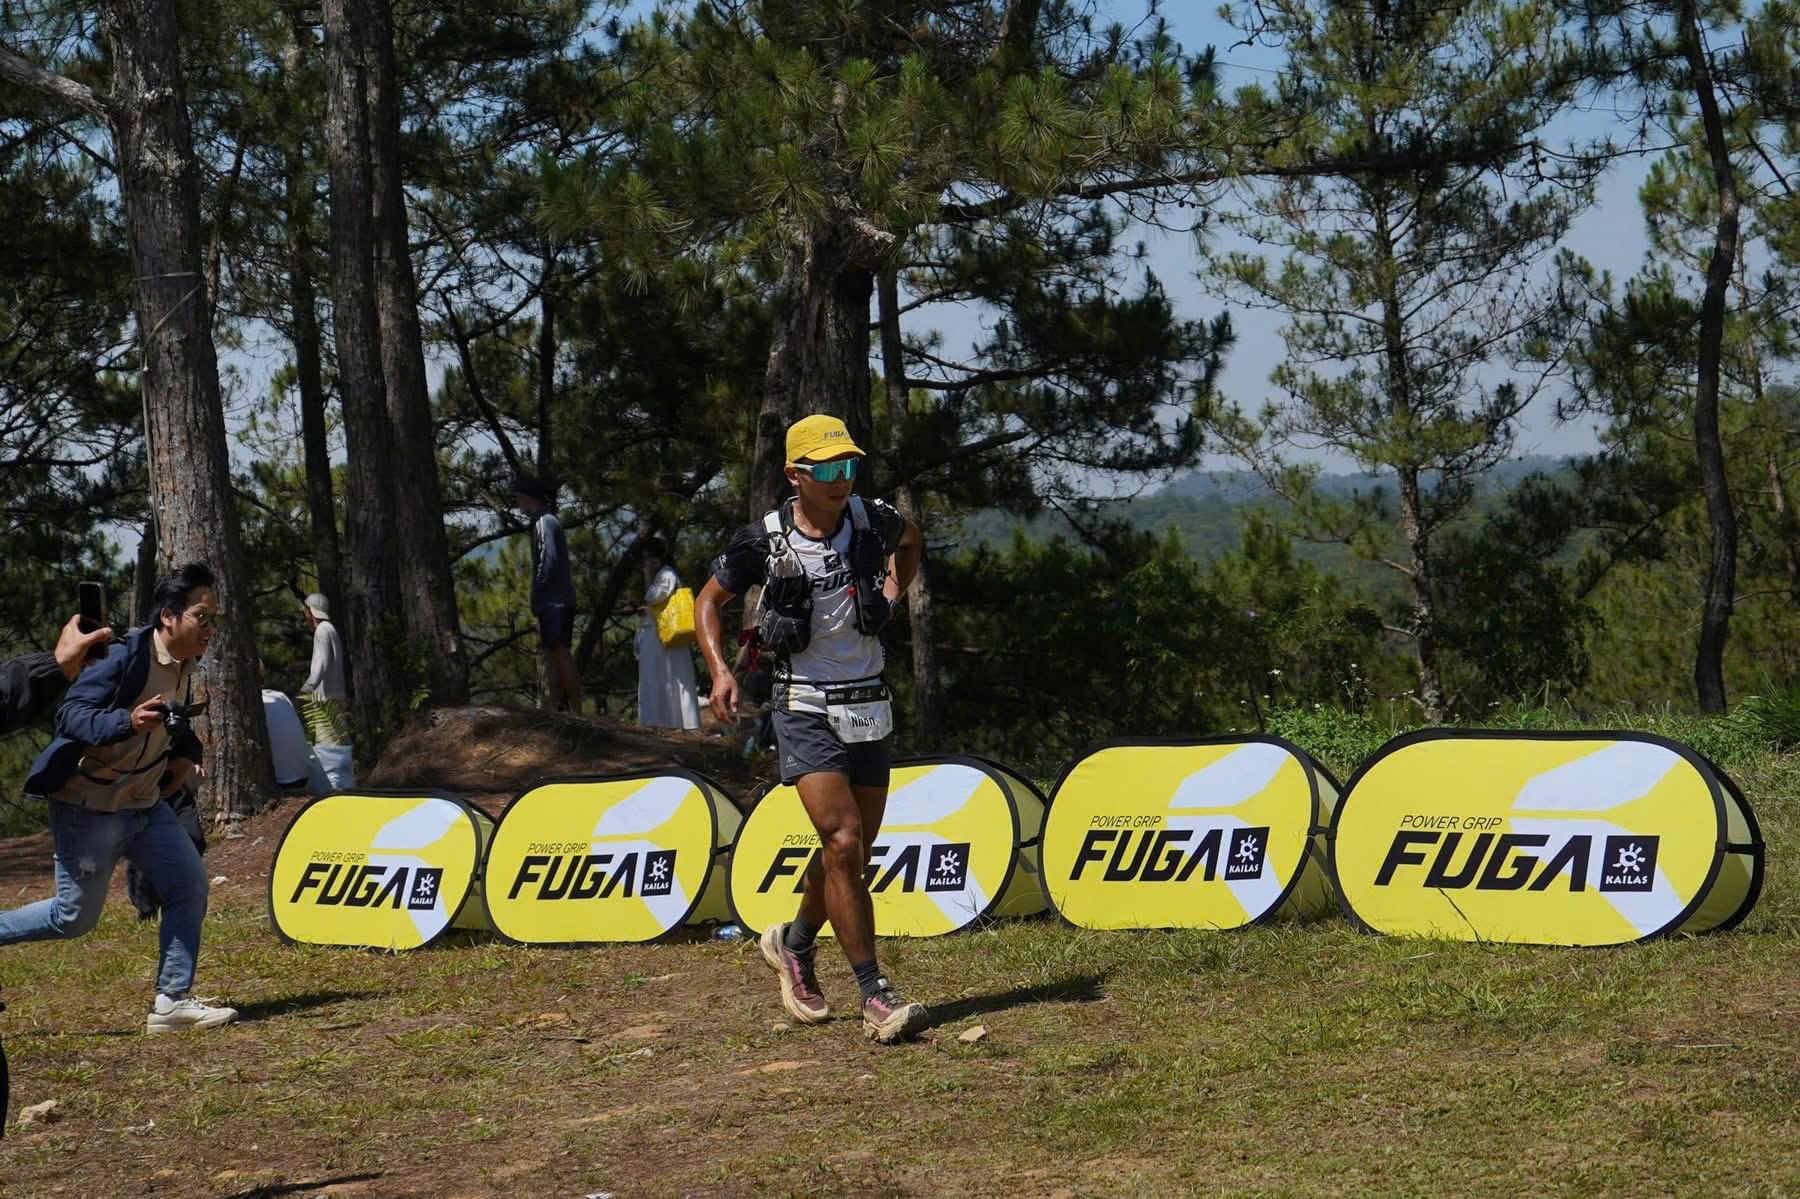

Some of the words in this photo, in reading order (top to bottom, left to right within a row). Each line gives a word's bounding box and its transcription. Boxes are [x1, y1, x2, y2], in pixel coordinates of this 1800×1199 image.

[1090, 815, 1130, 828] POWER
[1133, 815, 1162, 828] GRIP
[1400, 815, 1460, 829] POWER
[1463, 816, 1503, 830] GRIP
[528, 843, 561, 854] POWER
[563, 842, 588, 853] GRIP
[311, 851, 344, 863] POWER
[345, 853, 366, 864] GRIP
[1068, 829, 1229, 882] FUGA
[1373, 830, 1592, 892] FUGA
[507, 851, 638, 901] FUGA
[1229, 864, 1260, 875] KAILAS
[290, 863, 409, 909] FUGA
[643, 882, 671, 891] KAILAS
[929, 876, 962, 887] KAILAS
[1605, 874, 1649, 886] KAILAS
[411, 897, 434, 906] KAILAS
